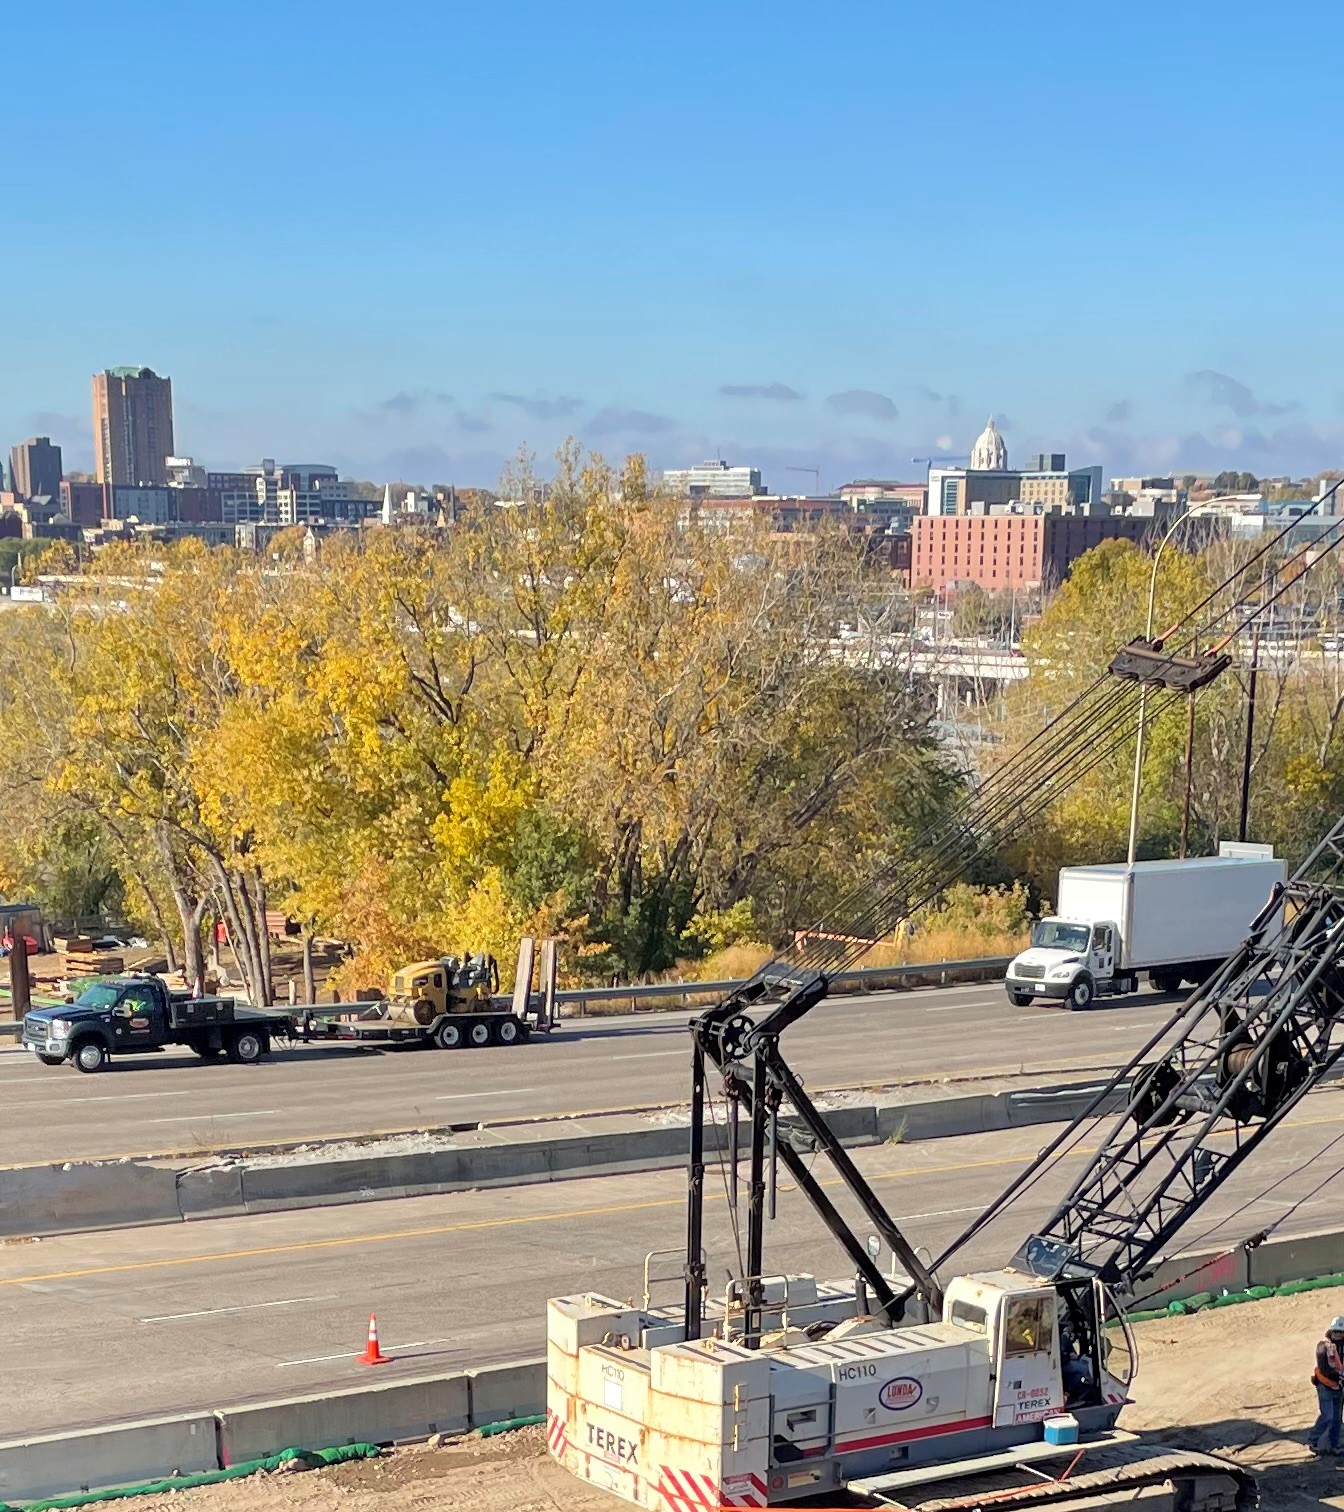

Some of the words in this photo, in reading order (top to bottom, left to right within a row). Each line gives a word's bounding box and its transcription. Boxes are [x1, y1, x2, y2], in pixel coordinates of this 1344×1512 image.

[601, 1363, 625, 1382] HC110
[839, 1364, 877, 1381] HC110
[1017, 1397, 1051, 1411] TEREX
[586, 1422, 639, 1465] TEREX
